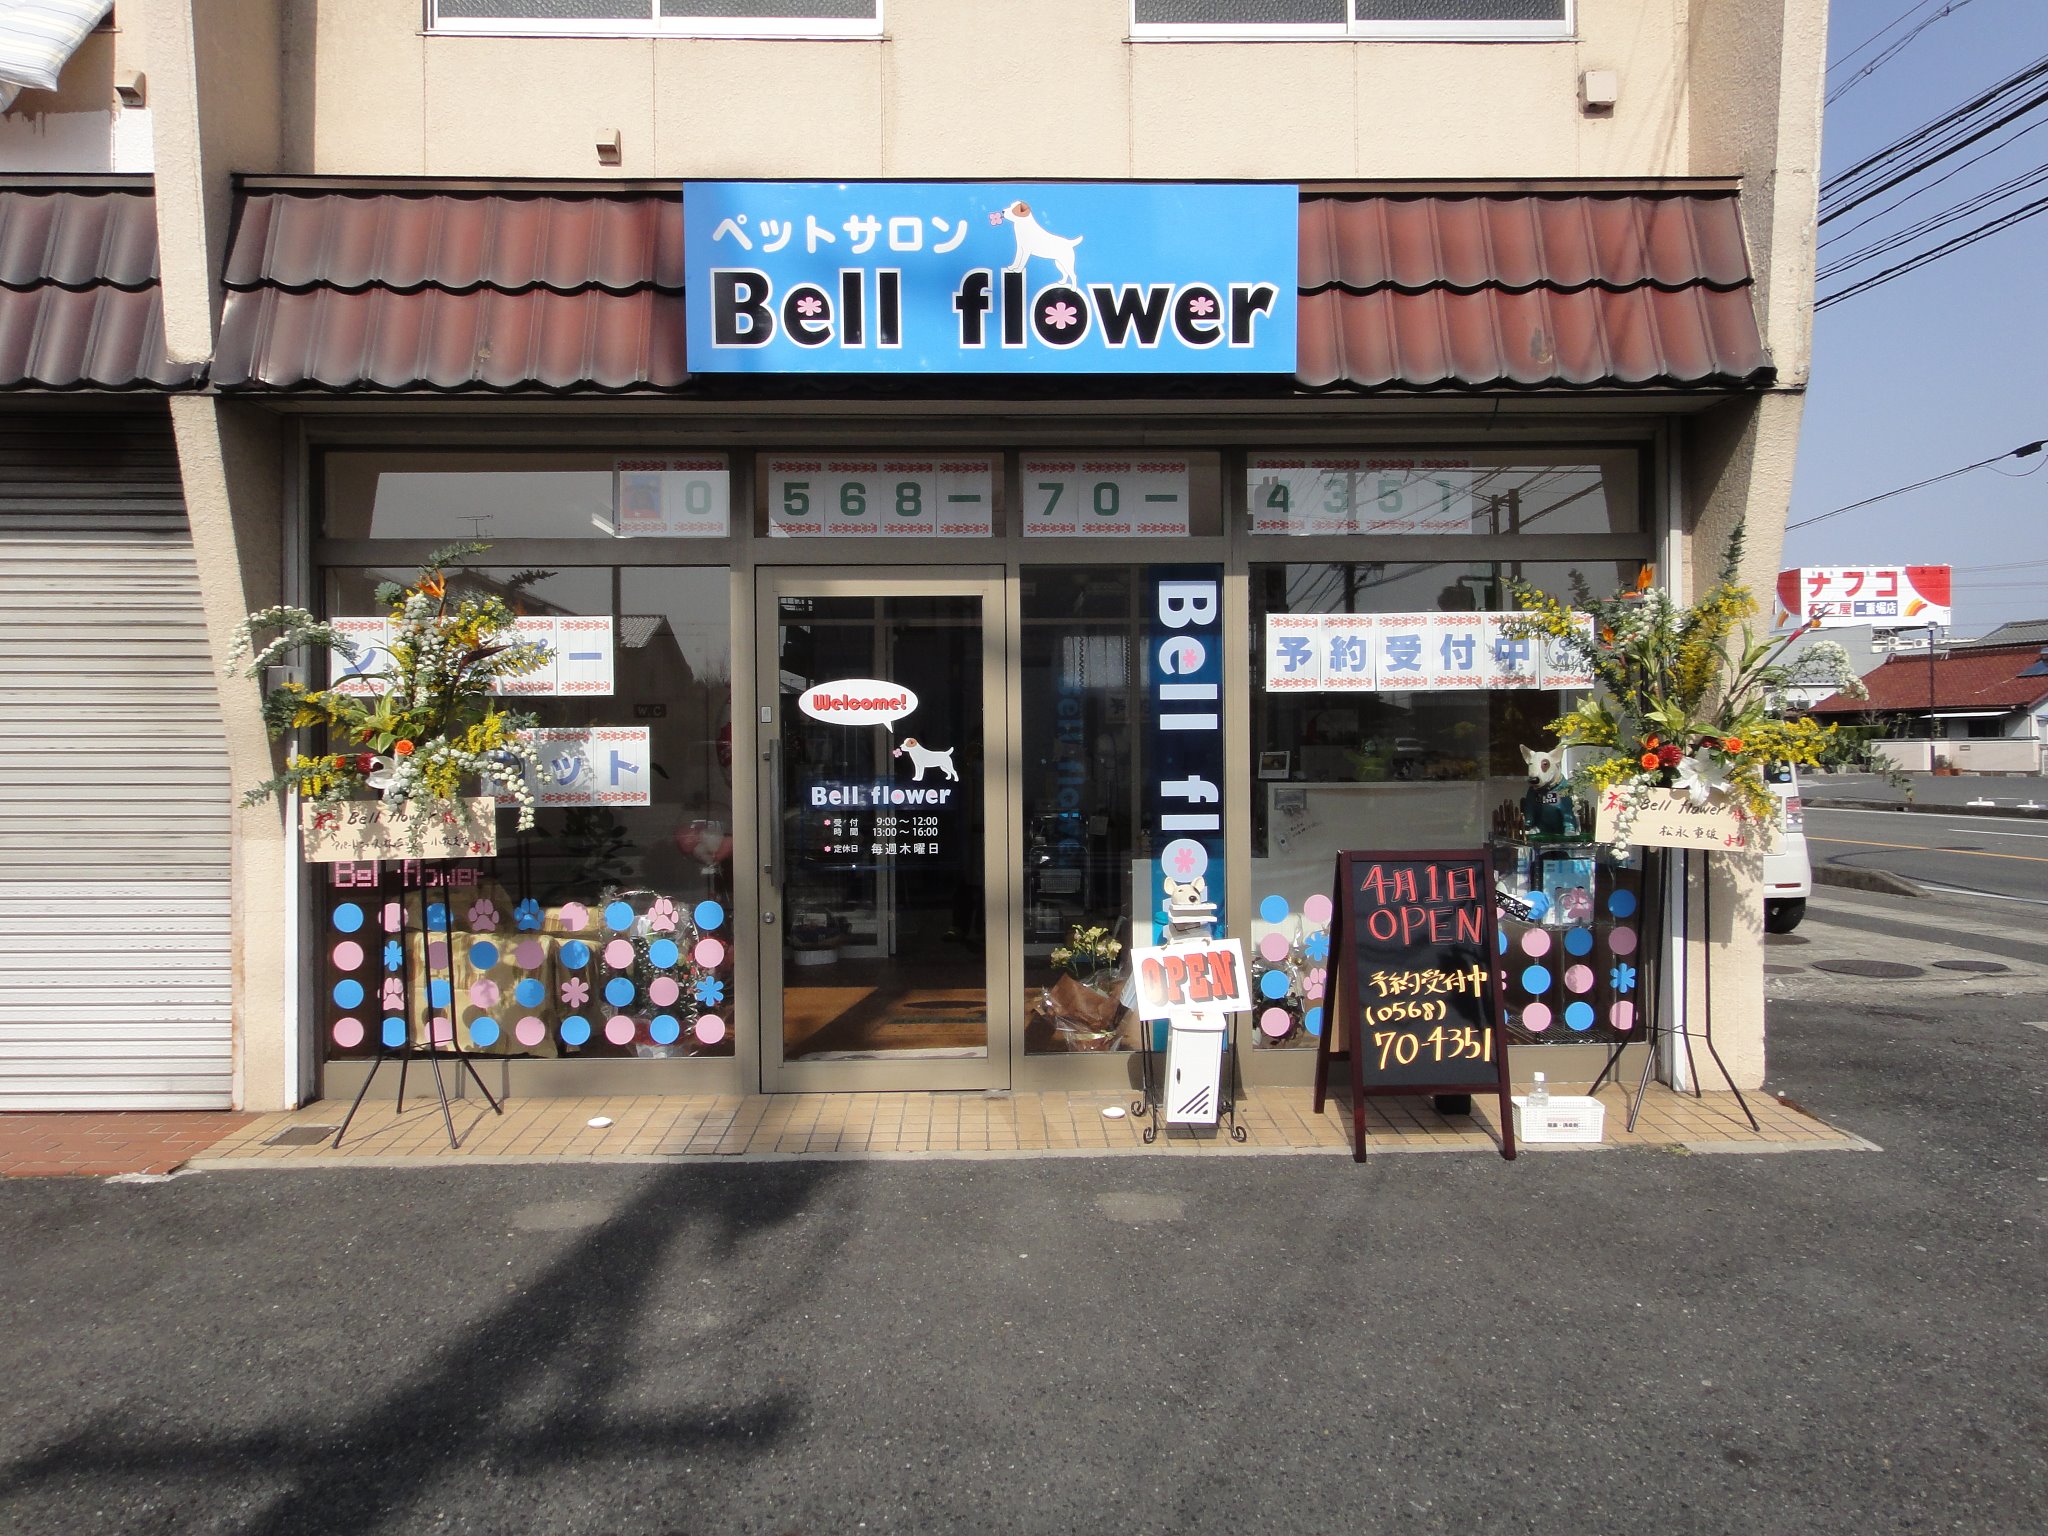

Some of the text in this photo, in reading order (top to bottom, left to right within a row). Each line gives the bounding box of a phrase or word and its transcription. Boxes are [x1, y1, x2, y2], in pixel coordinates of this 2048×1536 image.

[713, 214, 968, 254] ペットサロン
[710, 267, 1280, 350] Bell flower
[1807, 571, 1898, 598] ナフコ
[1158, 580, 1218, 730] Bell
[1275, 633, 1530, 673] 予約受付中
[813, 694, 907, 711] Welcome!
[811, 785, 951, 806] Bell flower
[1639, 799, 1671, 812] Bell
[833, 842, 939, 855] 定休日 毎週木曜日
[1360, 864, 1478, 905] 4月1日
[1367, 904, 1484, 945] OPEN
[1141, 950, 1240, 1007] OPEN
[1368, 964, 1489, 998] 予約受付中
[1365, 999, 1447, 1026] (0568)
[1373, 1025, 1492, 1071] 70-4351
